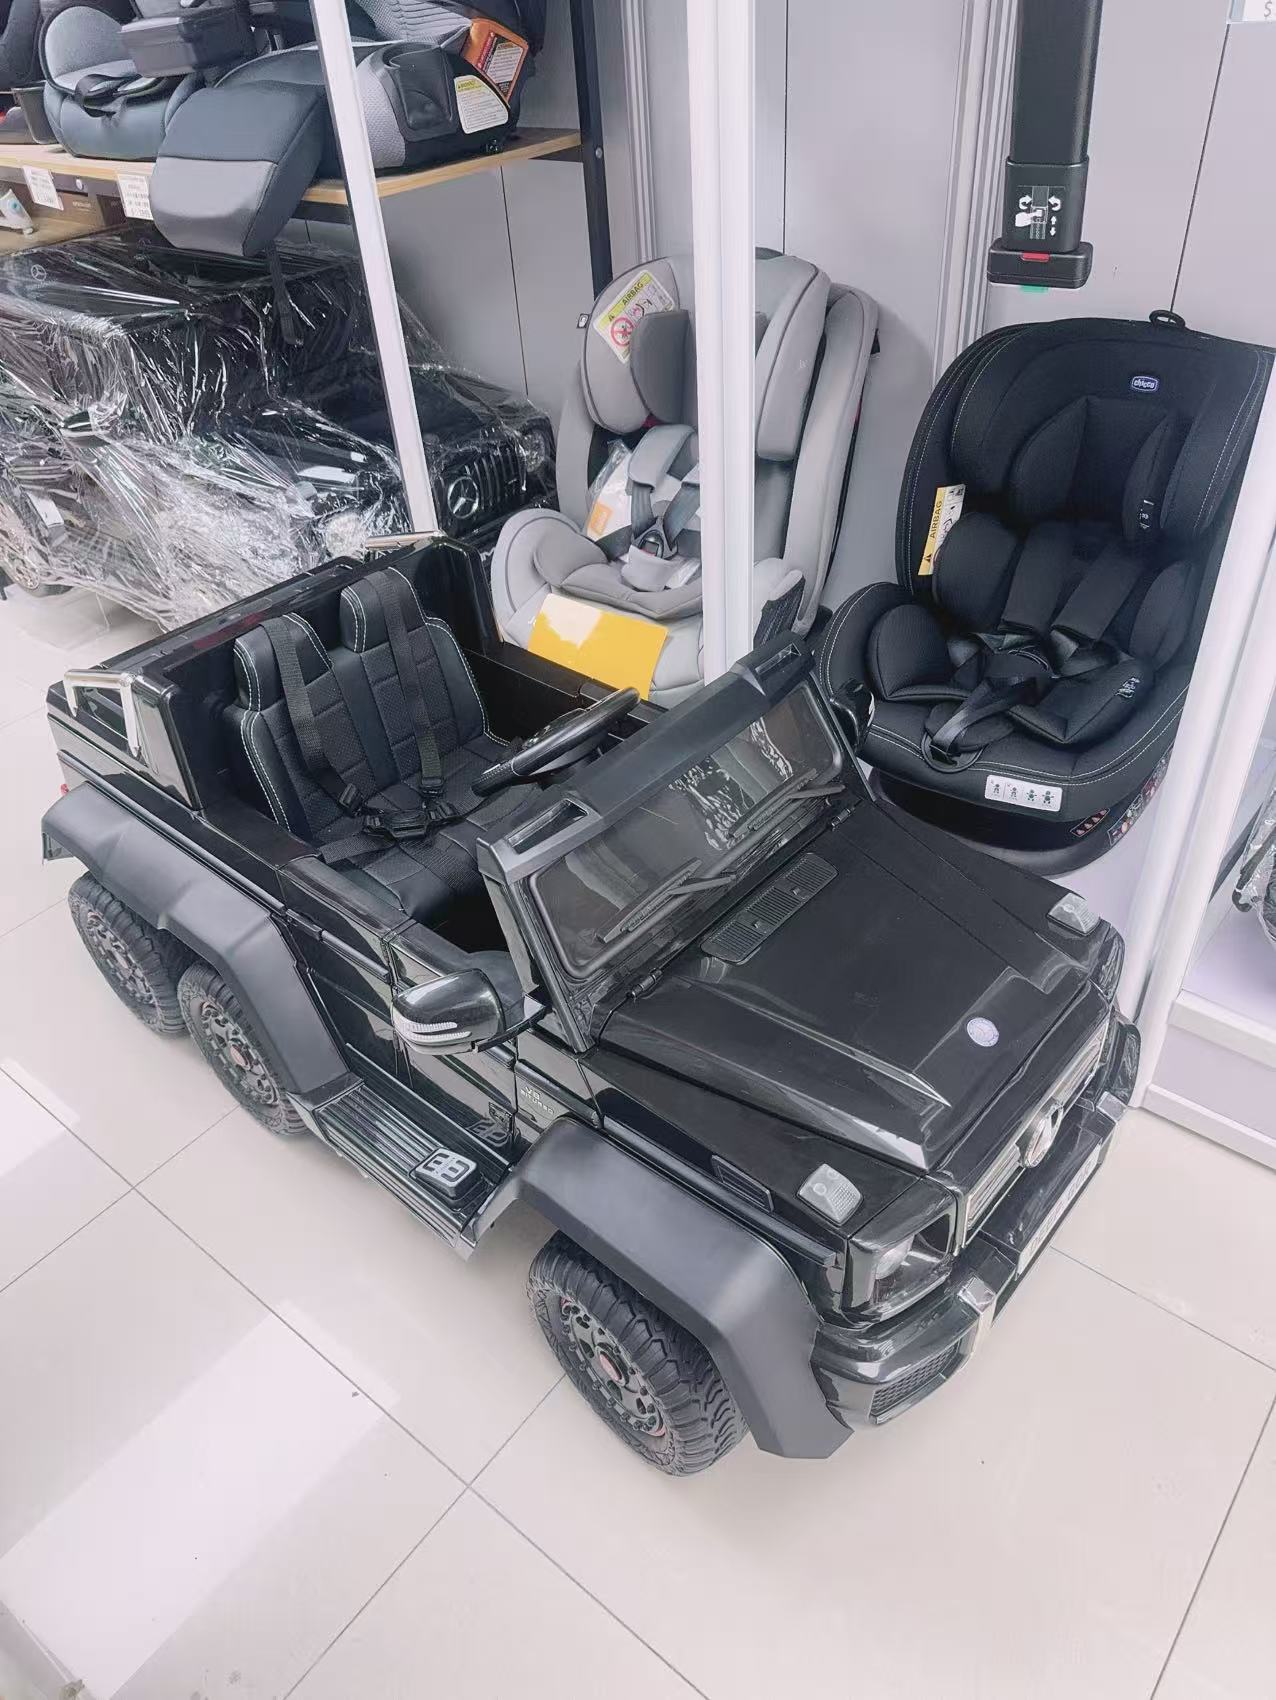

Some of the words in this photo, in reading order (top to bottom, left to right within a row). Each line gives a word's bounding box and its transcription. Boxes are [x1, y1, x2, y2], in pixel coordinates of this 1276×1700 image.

[622, 282, 644, 306] AIRBAG
[1133, 379, 1155, 389] chicco
[929, 500, 943, 539] AIRBAG
